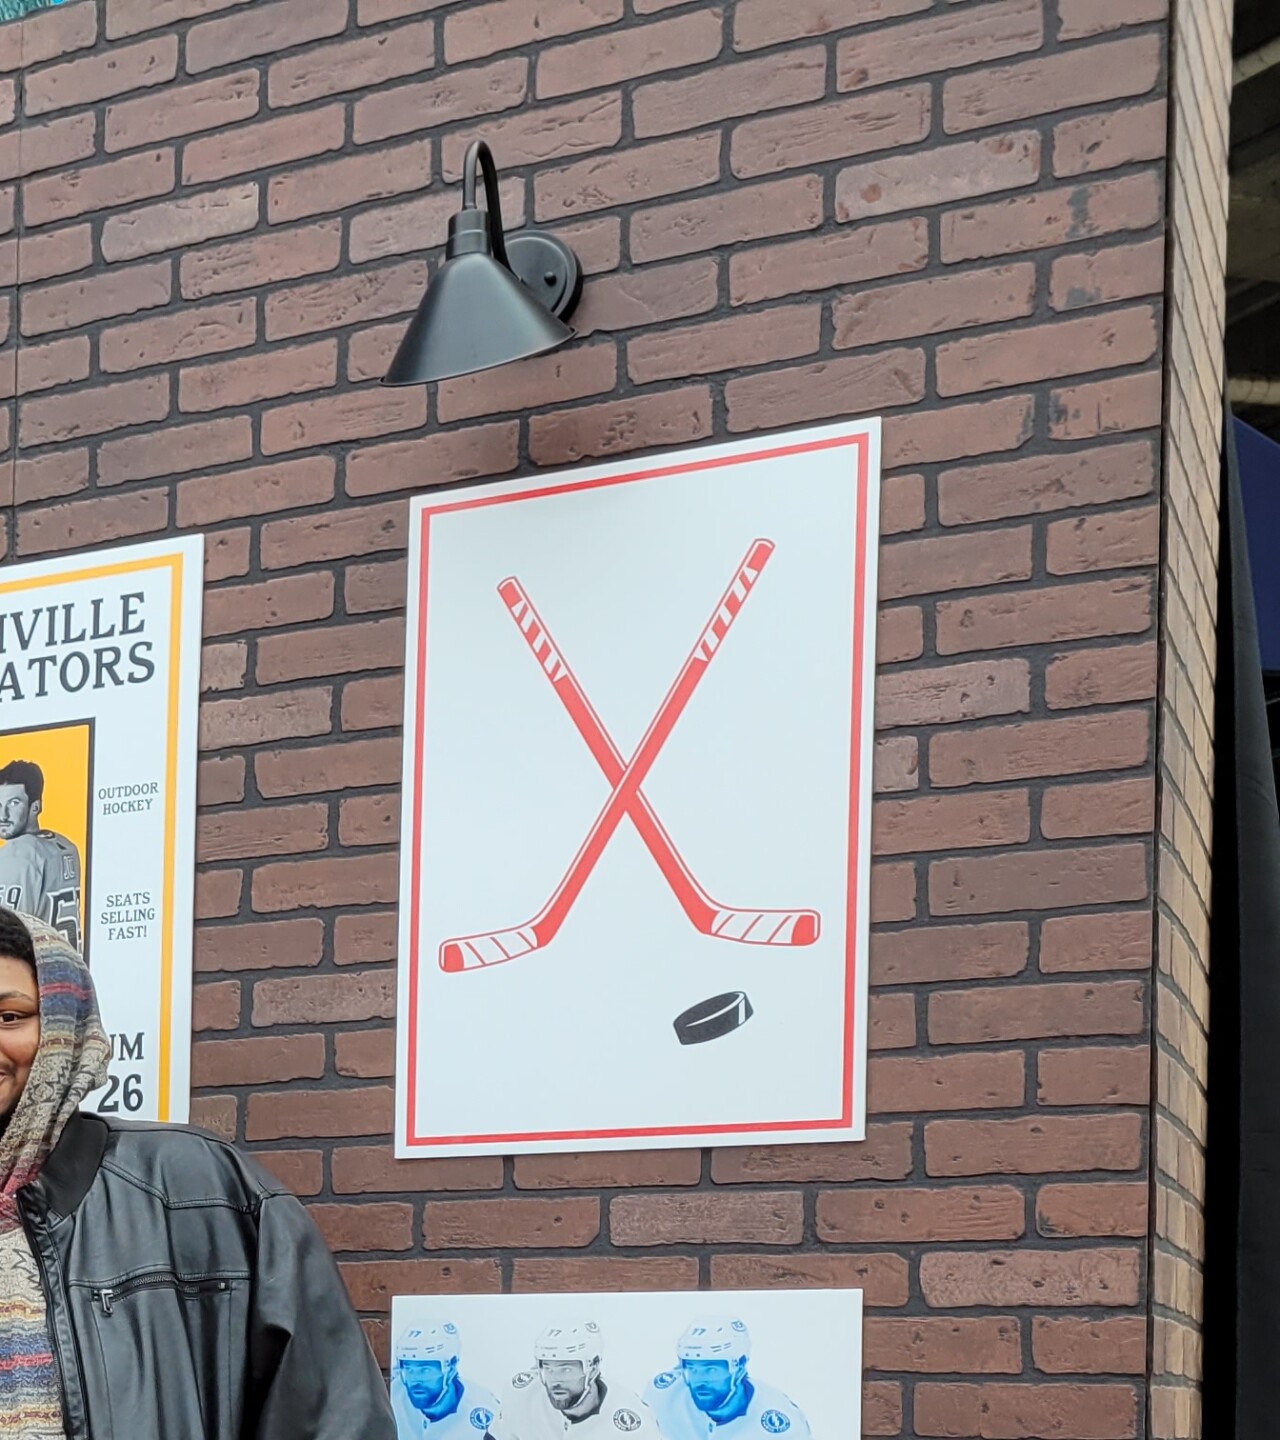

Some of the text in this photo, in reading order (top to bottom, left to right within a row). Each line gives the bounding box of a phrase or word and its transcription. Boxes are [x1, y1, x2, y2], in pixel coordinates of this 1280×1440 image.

[98, 782, 159, 800] OUTDOOR
[102, 799, 154, 816] HOCKEY
[106, 892, 151, 908] SEATS
[100, 908, 156, 925] SELLING
[107, 926, 148, 941] FAST!
